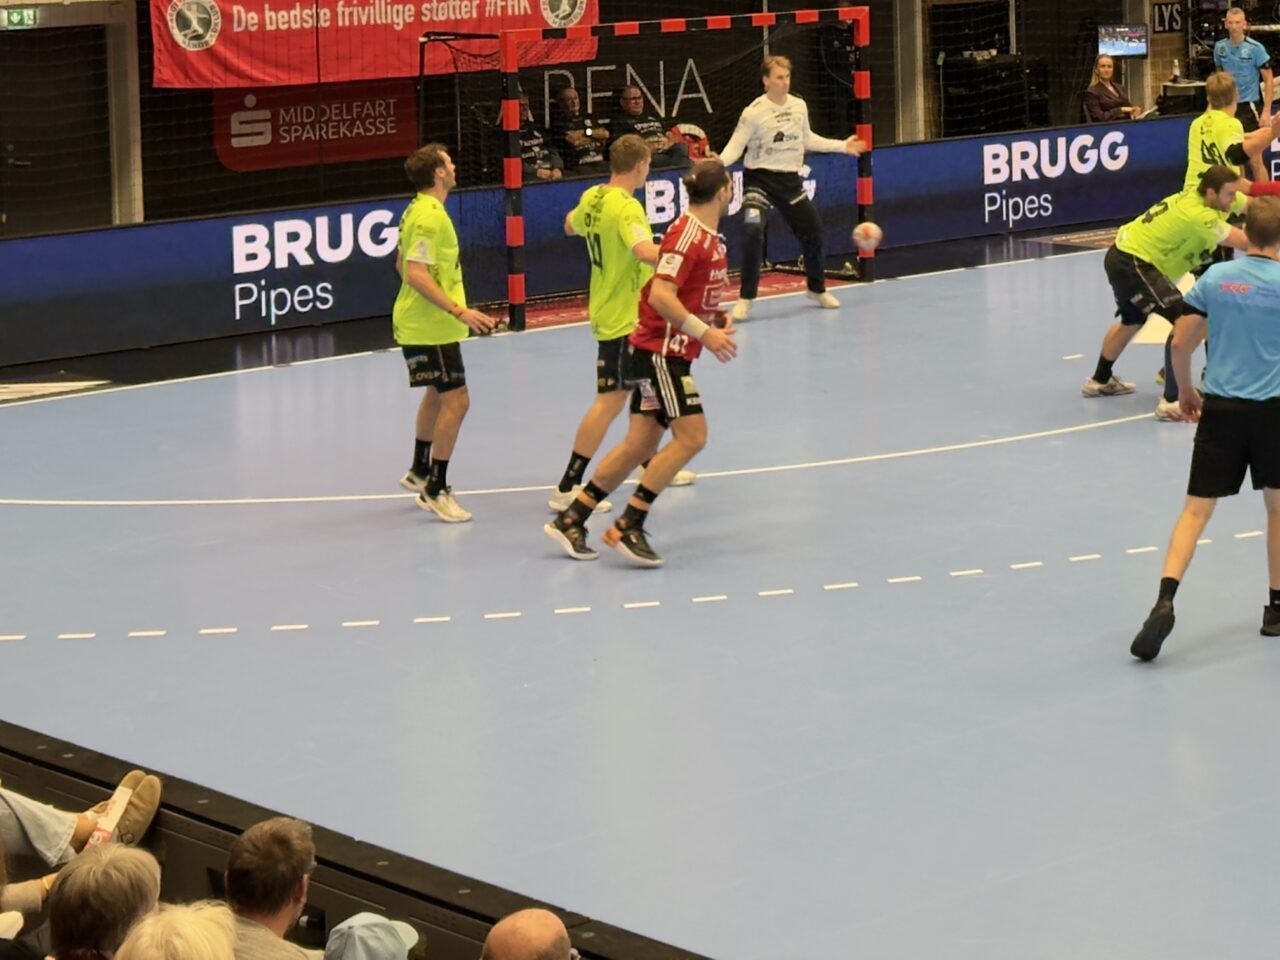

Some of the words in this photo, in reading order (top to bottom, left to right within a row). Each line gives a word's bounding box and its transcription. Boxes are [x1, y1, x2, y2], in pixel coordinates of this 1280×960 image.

[232, 5, 259, 33] De
[264, 2, 331, 31] bedste
[1154, 3, 1182, 32] LYS
[280, 98, 399, 126] MIDDELFART
[280, 117, 398, 144] SPAREKASSE
[983, 131, 1129, 185] BRUGG
[984, 189, 1053, 228] Pipes
[232, 209, 400, 275] BRUG
[234, 279, 334, 326] Pipes
